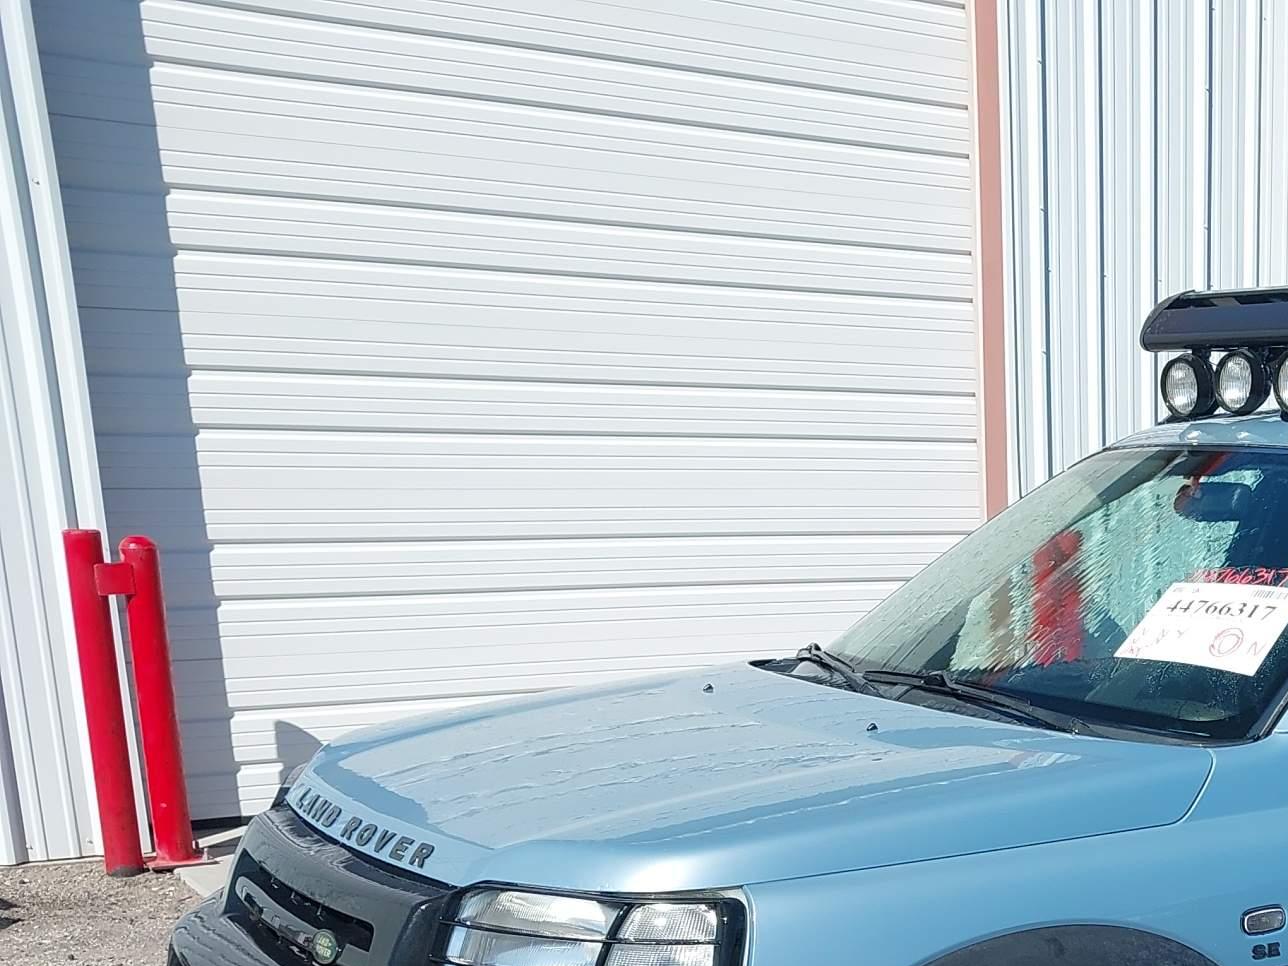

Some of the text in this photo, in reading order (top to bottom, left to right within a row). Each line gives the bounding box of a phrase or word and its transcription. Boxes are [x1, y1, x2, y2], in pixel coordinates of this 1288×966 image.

[1167, 599, 1277, 621] 44766317
[298, 787, 435, 869] LAND ROVER
[1251, 942, 1281, 960] SE
